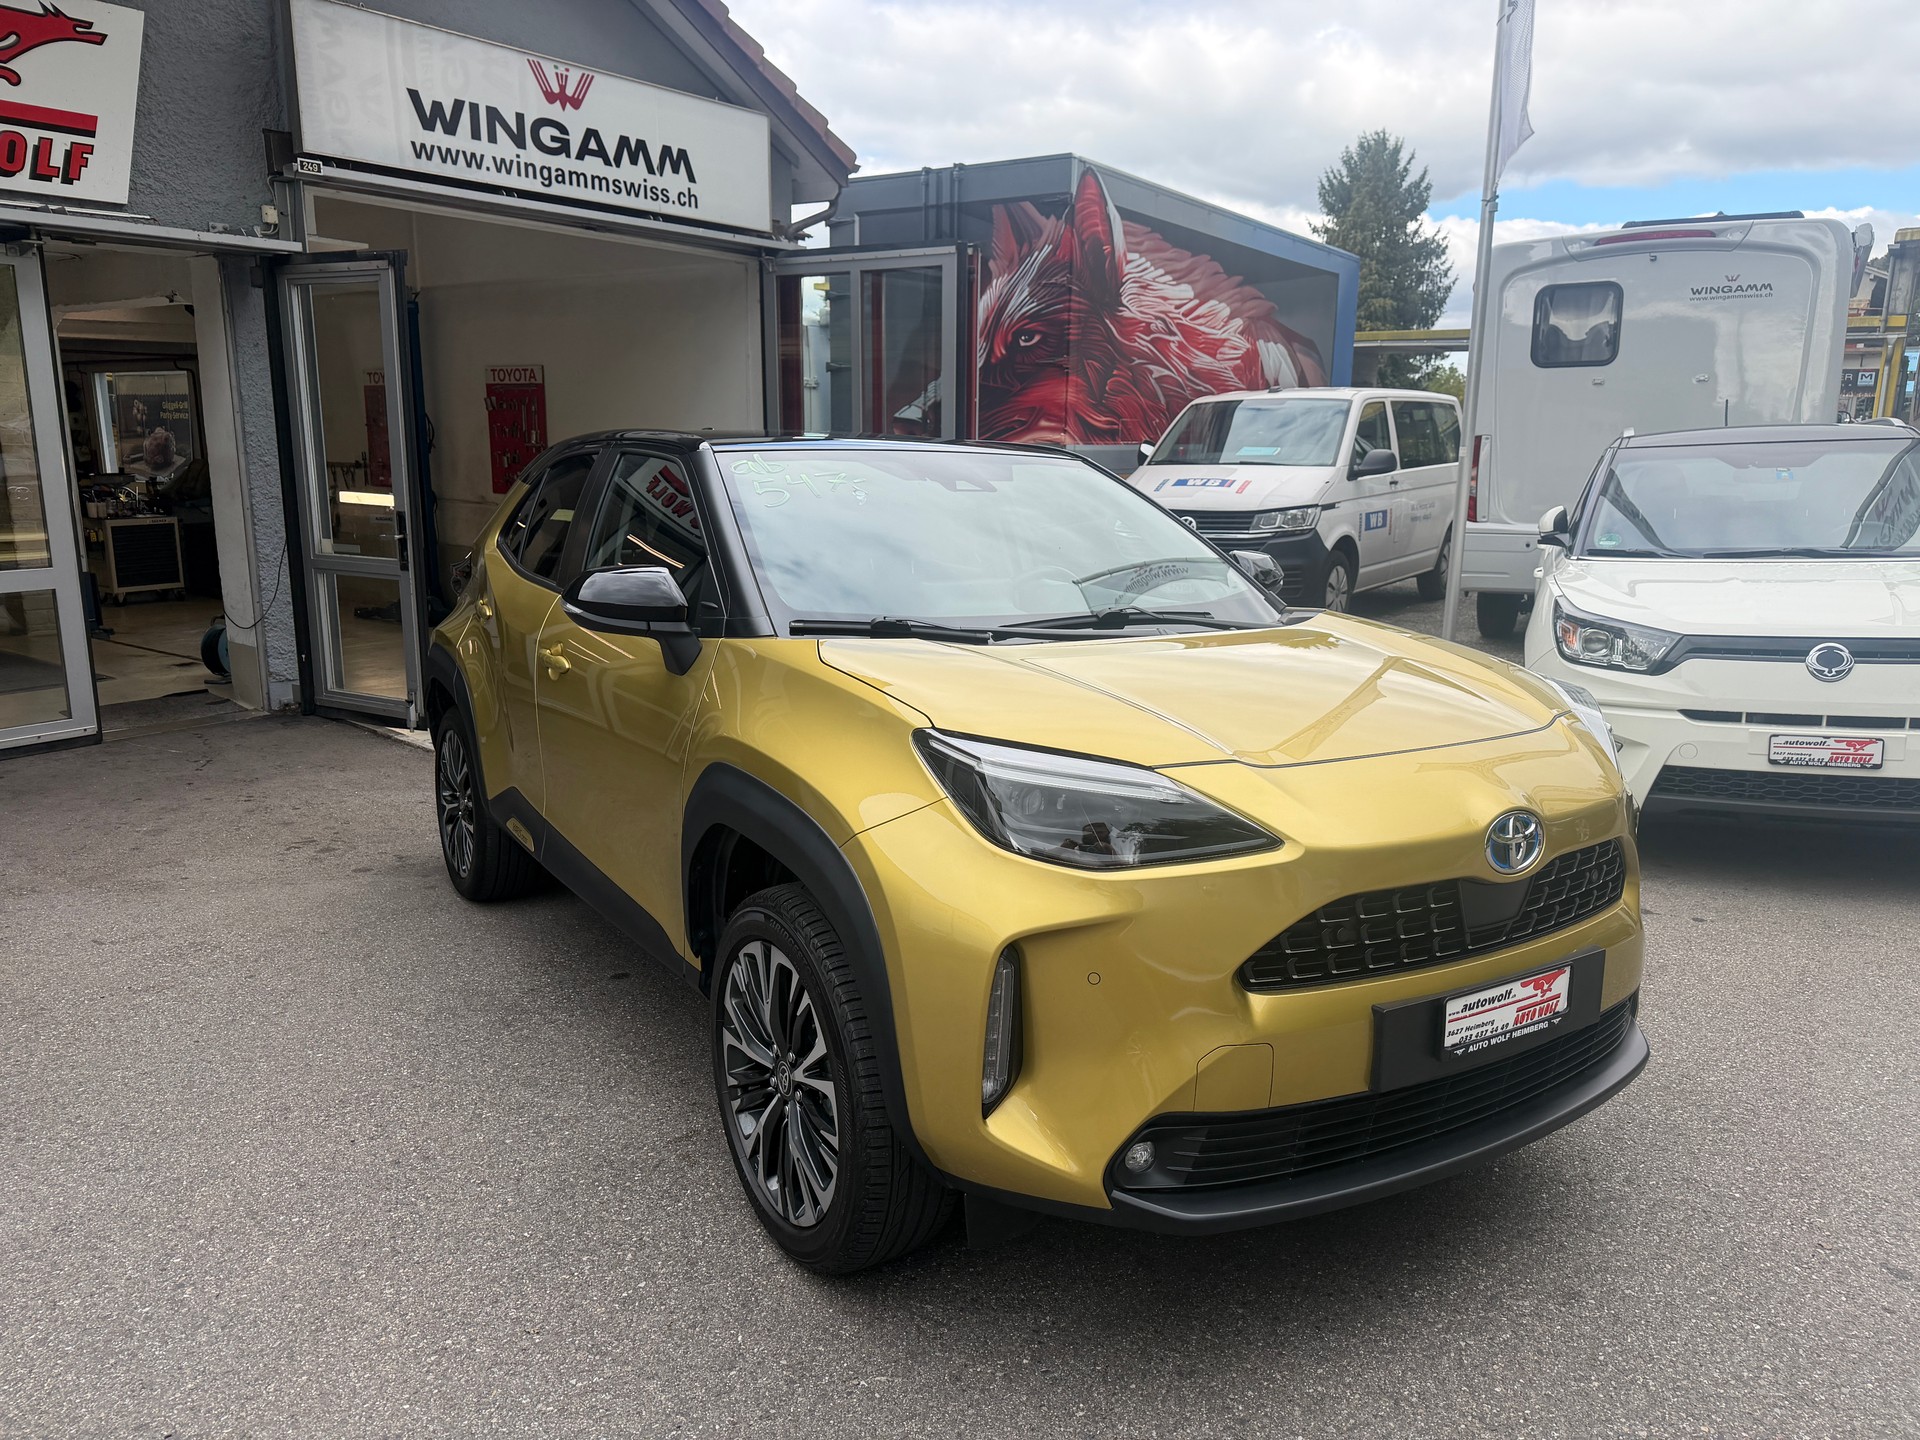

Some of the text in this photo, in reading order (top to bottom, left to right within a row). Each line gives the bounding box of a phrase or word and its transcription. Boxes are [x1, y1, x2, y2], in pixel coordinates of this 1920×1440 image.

[405, 87, 697, 184] WINGAMM
[302, 161, 319, 173] 249
[410, 140, 699, 209] www.wingammswiss.ch
[1690, 283, 1773, 295] WINGAMM
[490, 368, 537, 382] TOYOTA
[1369, 511, 1383, 529] WB
[1512, 1000, 1560, 1027] AUTO WOLF
[1446, 1019, 1495, 1038] 3627 Heimberg
[1459, 1033, 1473, 1043] 033
[1475, 1029, 1488, 1040] 437
[1468, 1021, 1549, 1053] AUTO WOLF HEIMBERG
